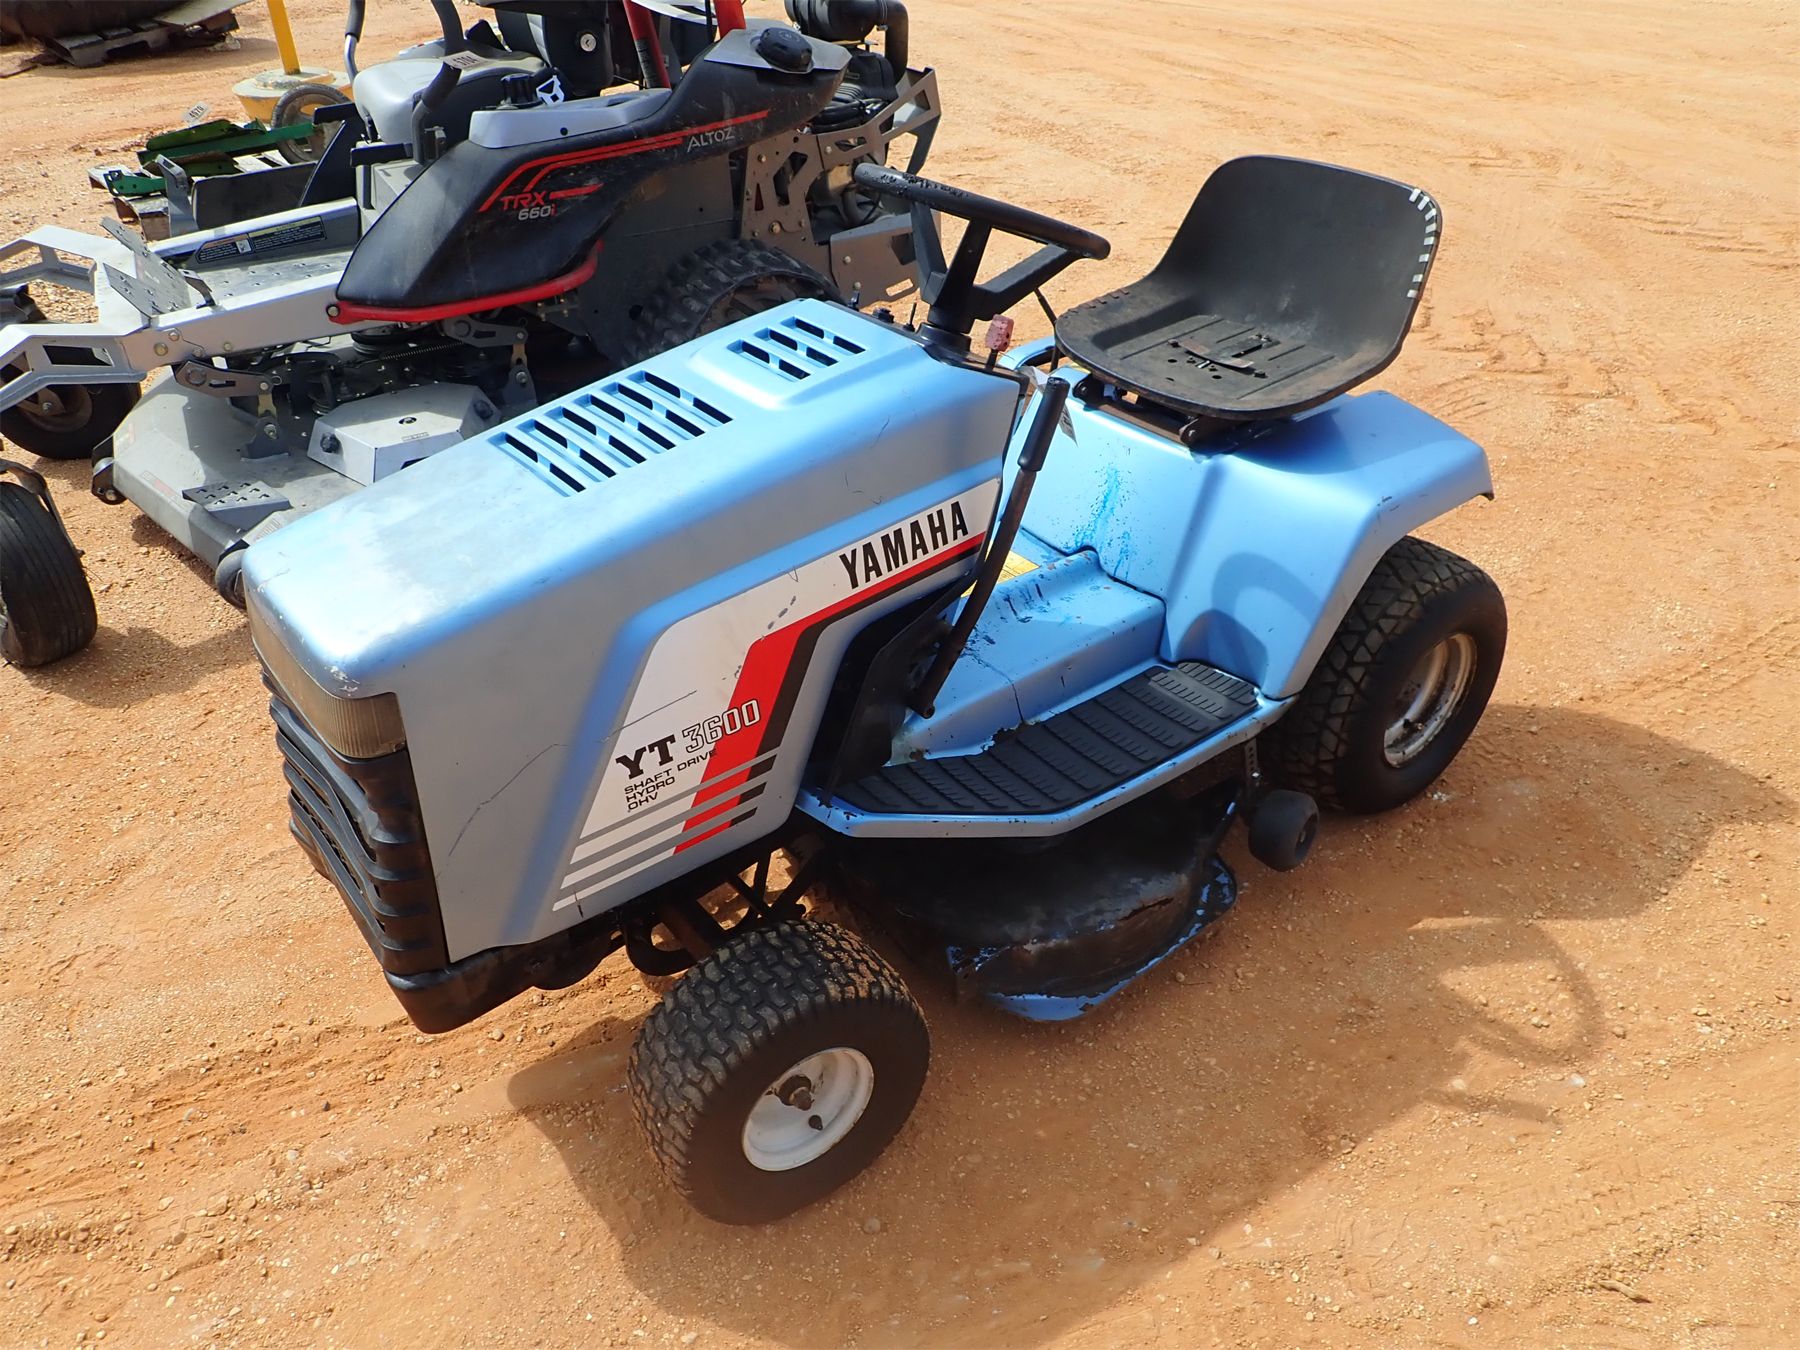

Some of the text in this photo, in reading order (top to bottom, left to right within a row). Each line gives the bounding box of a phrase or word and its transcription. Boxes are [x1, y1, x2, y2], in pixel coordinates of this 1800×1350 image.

[687, 127, 735, 153] ALTOZ
[501, 191, 547, 210] TRX
[518, 203, 557, 220] 660i
[839, 501, 969, 590] YAMAHA
[615, 698, 761, 780] YT 3600
[624, 748, 718, 795] SHAFT DRIVE
[626, 776, 675, 803] HYDRO
[628, 792, 658, 811] OHV
